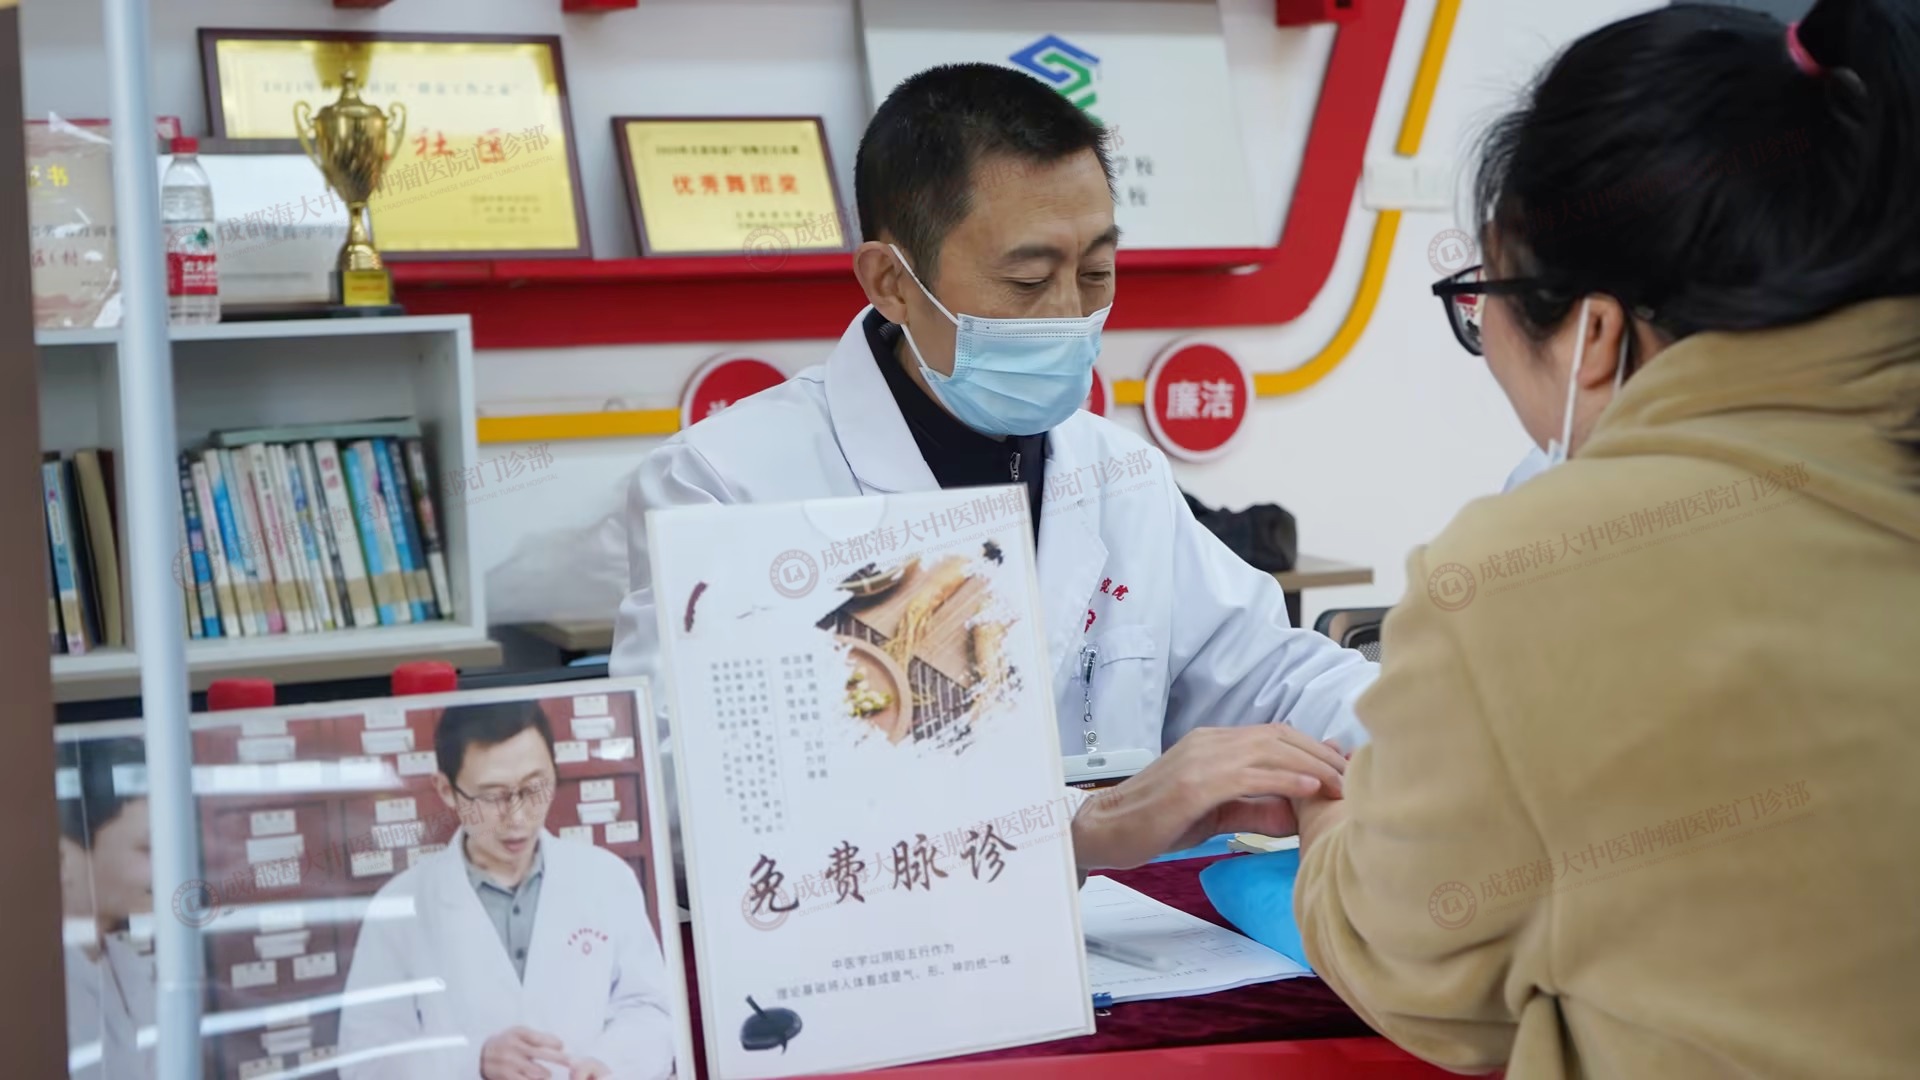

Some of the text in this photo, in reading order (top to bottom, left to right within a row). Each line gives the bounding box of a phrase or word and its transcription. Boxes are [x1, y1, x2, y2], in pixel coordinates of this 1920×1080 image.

[672, 173, 798, 196] 优秀舞团奖
[1165, 380, 1236, 421] 廉洁
[749, 825, 1017, 915] 免费脉诊
[832, 944, 954, 970] 中医学以阴阳五行作为
